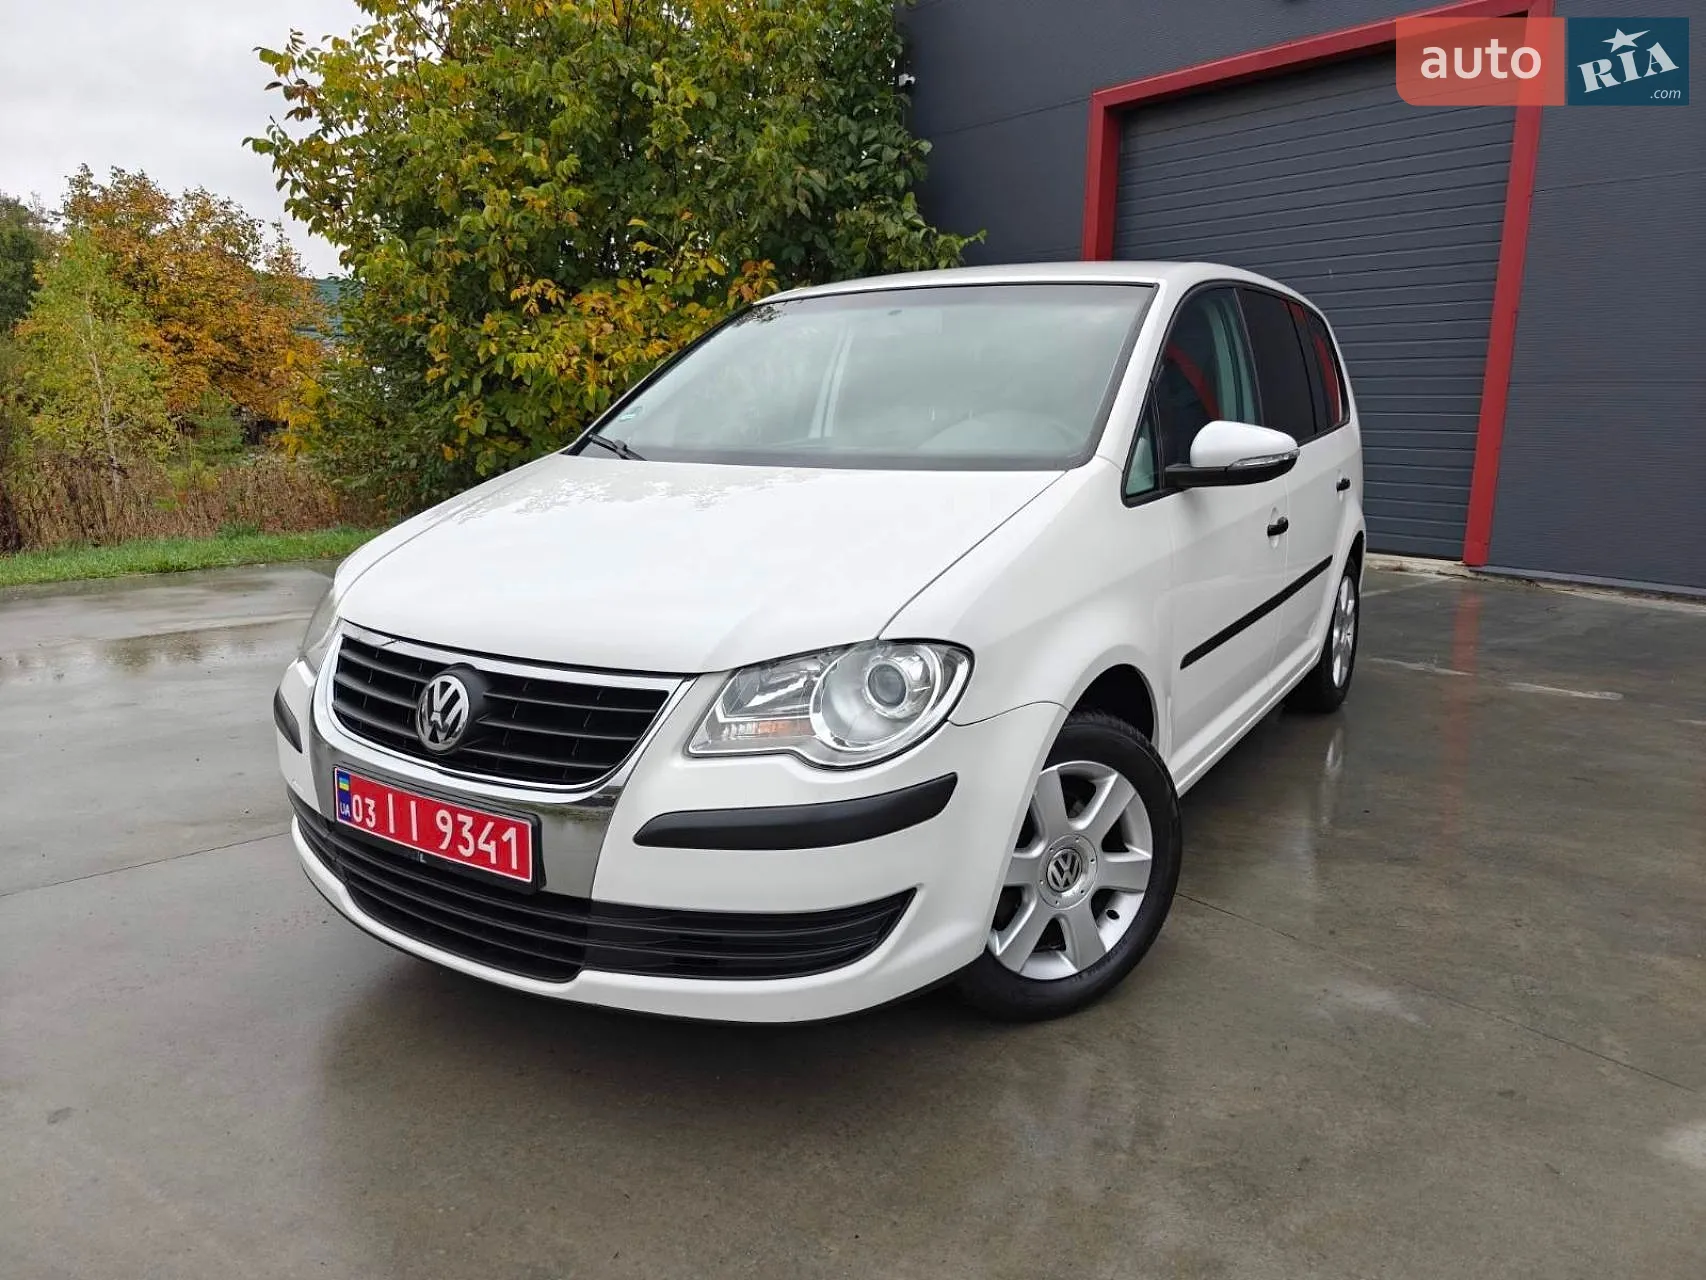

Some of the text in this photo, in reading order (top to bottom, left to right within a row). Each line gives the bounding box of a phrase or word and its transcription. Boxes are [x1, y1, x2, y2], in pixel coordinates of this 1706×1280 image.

[340, 801, 351, 817] UA
[352, 794, 376, 828] 03
[435, 810, 518, 870] 9341
